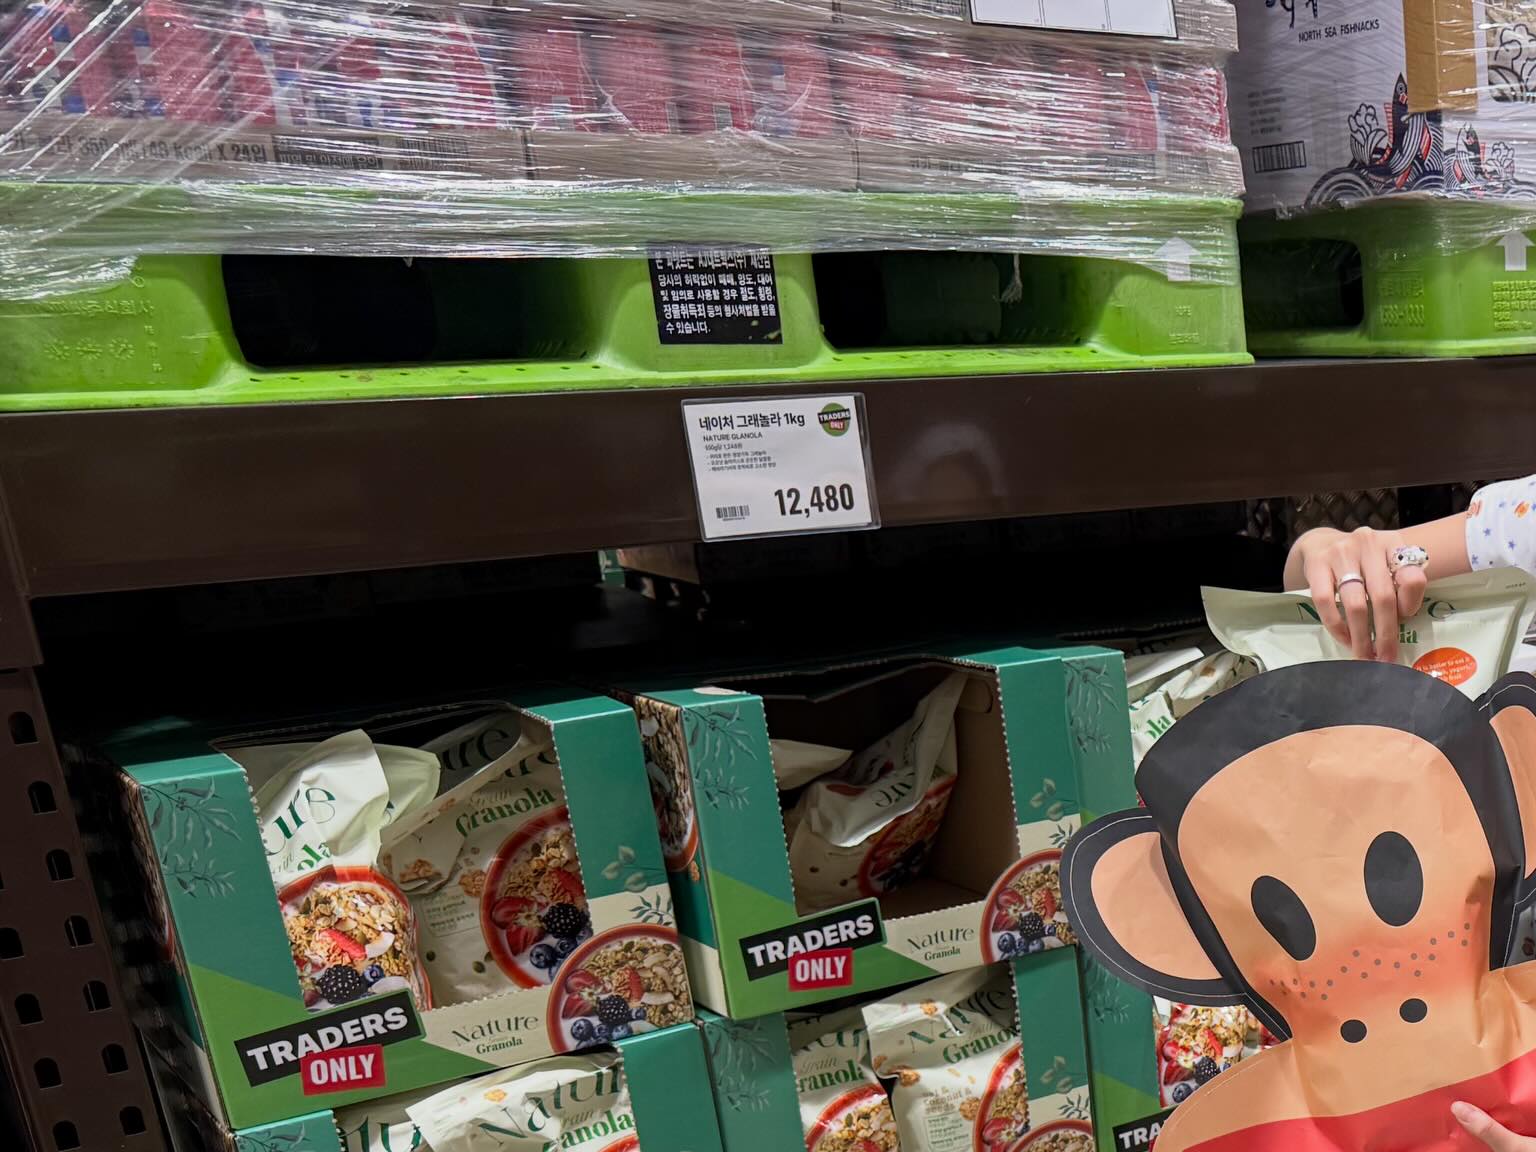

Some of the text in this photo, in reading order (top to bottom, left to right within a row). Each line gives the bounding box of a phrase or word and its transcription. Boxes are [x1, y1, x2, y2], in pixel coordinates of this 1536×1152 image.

[1299, 19, 1380, 42] NORTH SEA FISHNACKS
[658, 274, 682, 286] 당사의
[685, 273, 716, 286] 허락없이
[671, 290, 694, 300] 임의로
[697, 290, 720, 300] 사용할
[723, 289, 738, 299] 경우
[707, 305, 722, 318] 등의
[666, 322, 711, 334] 수 있습니다.
[699, 413, 805, 431] 네이처 그래놀라 1kg
[819, 409, 850, 422] TRADERS
[703, 432, 762, 442] NATURE GLANOLA
[775, 484, 854, 517] 12,480
[748, 915, 874, 968] TRADERS
[907, 926, 974, 953] Nature
[924, 947, 961, 962] Granola
[795, 956, 846, 983] ONLY
[248, 1007, 408, 1071] TRADERS
[451, 1014, 538, 1044] Nature
[476, 1036, 523, 1055] Granola
[943, 1027, 1020, 1064] Grano
[310, 1053, 375, 1085] ONLY
[479, 1063, 625, 1145] Natur
